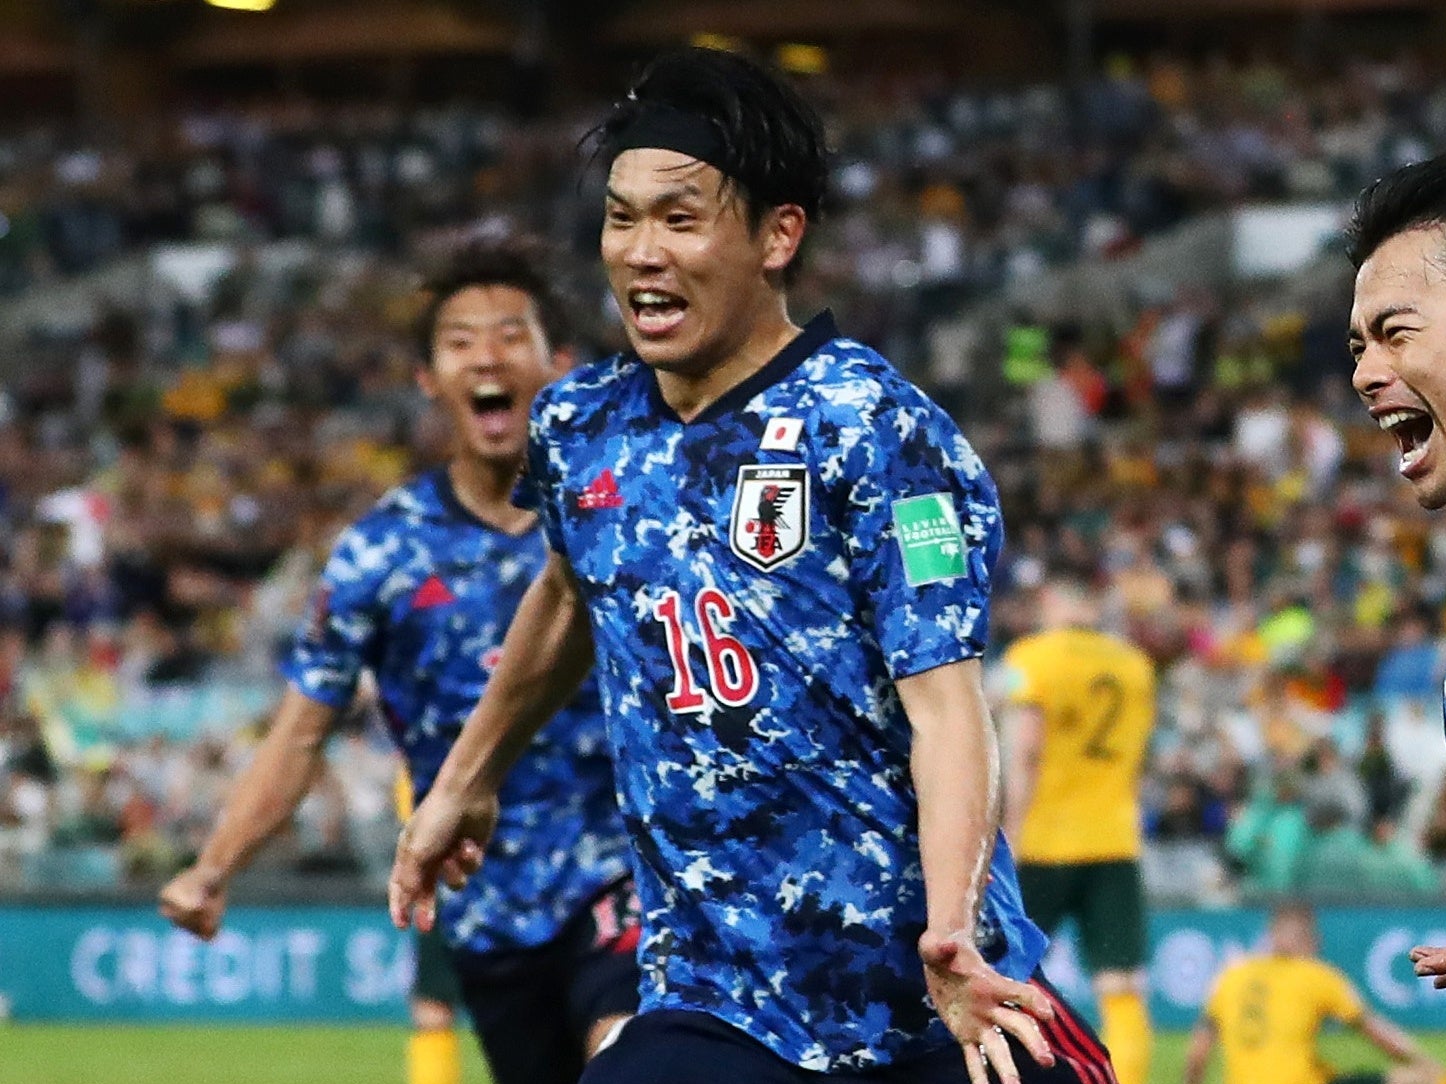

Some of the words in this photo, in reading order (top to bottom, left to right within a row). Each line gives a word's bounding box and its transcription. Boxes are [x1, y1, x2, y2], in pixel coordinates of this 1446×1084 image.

[755, 469, 790, 479] JAPAN
[653, 586, 759, 714] 16
[70, 925, 325, 1005] CREDIT
